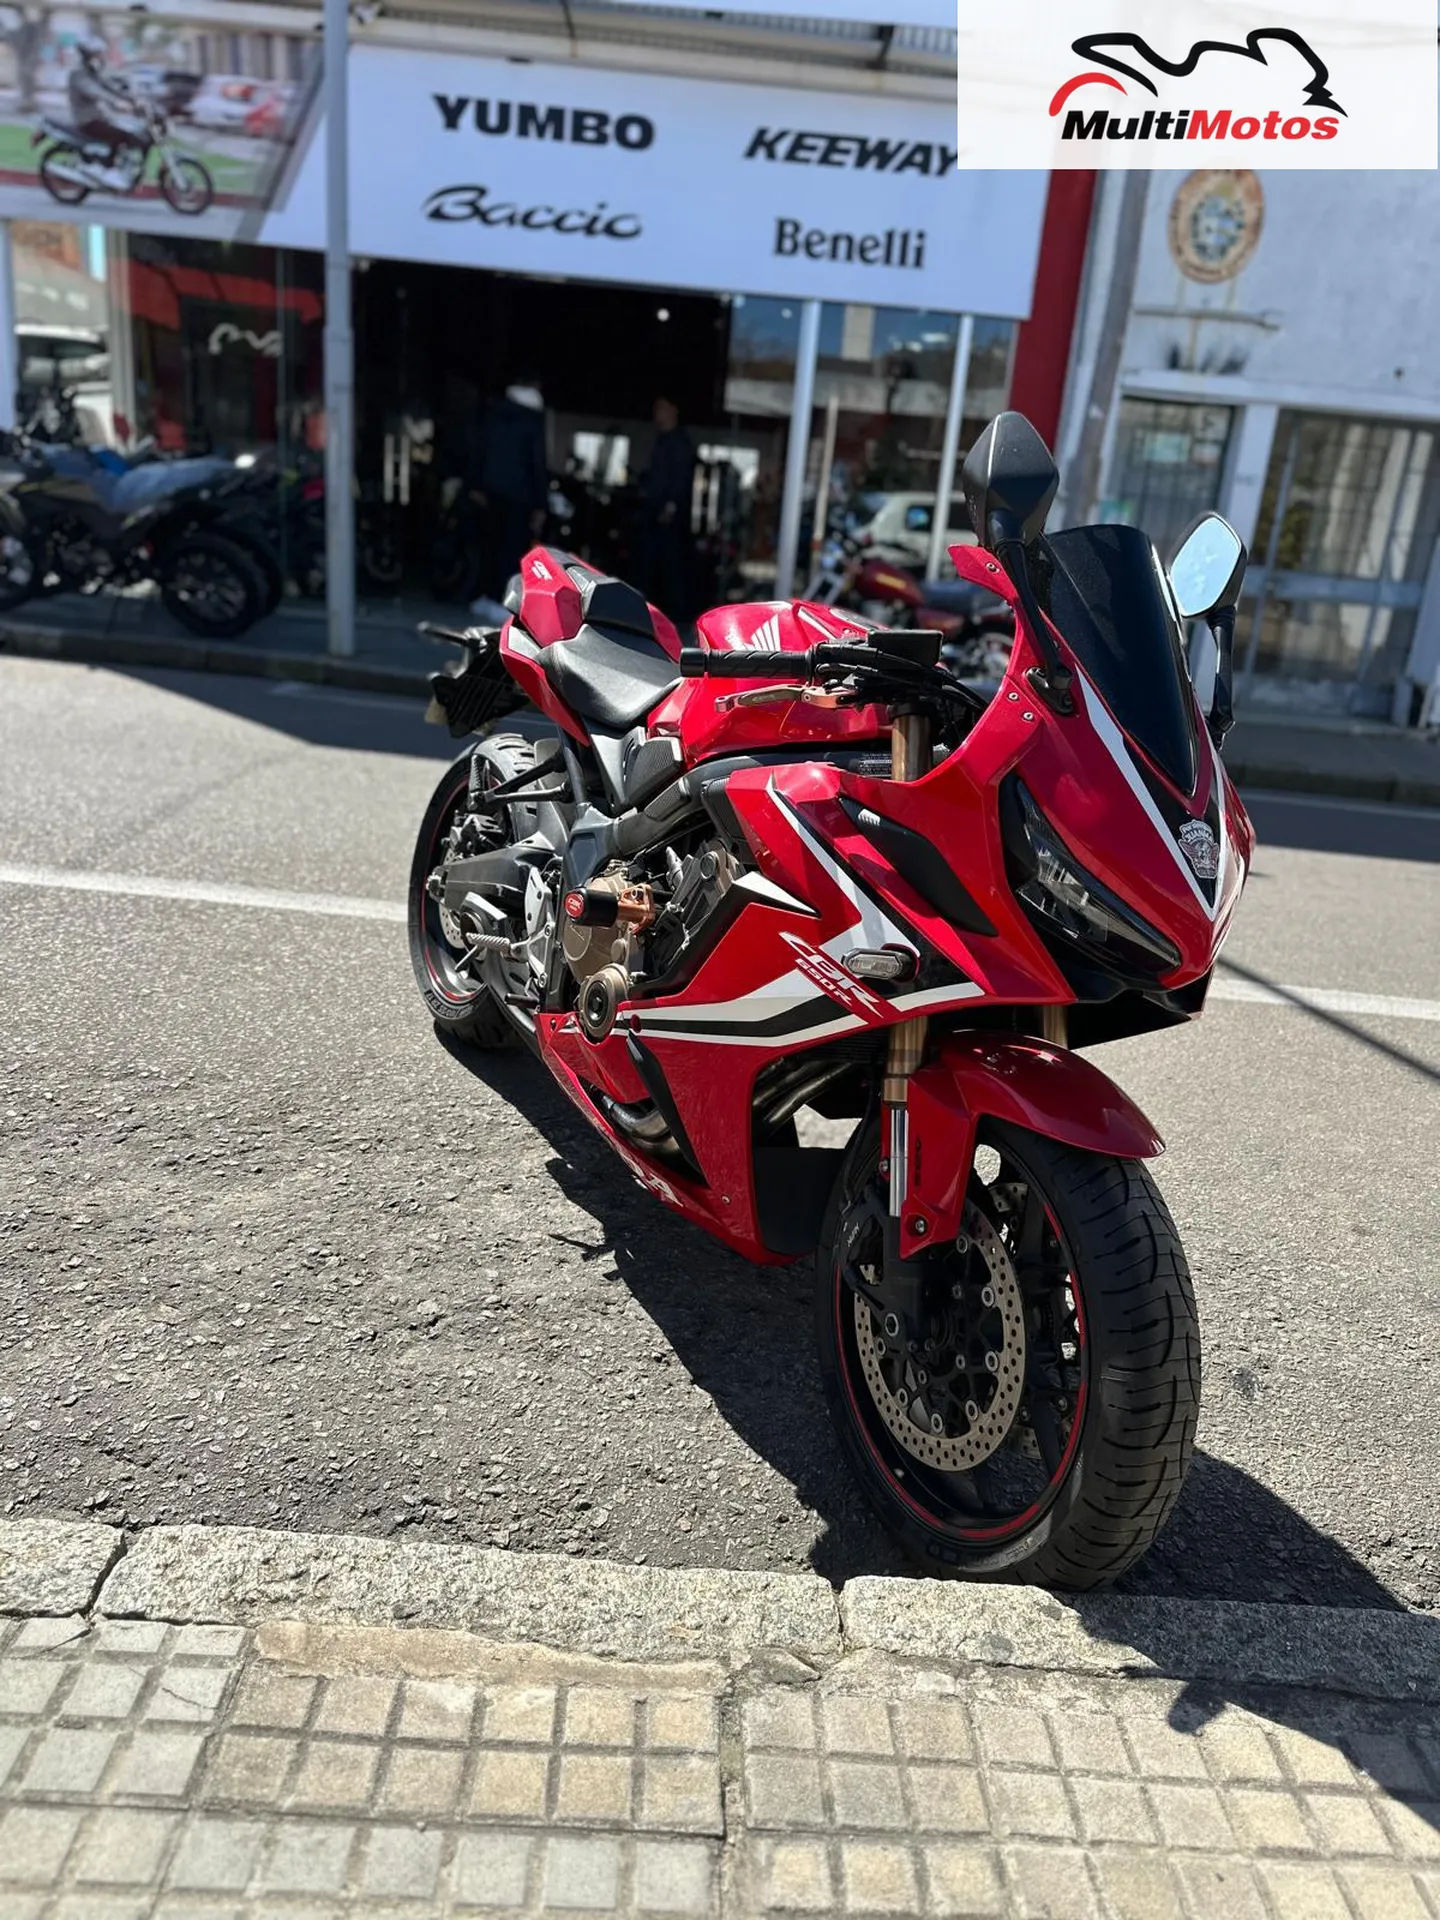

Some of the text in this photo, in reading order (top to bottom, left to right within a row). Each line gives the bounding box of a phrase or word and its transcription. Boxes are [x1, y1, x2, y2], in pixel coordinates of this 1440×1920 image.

[433, 94, 655, 150] YUMBO
[743, 127, 958, 177] KEEWAY
[424, 185, 642, 239] Baccio
[774, 217, 926, 269] Benelli
[778, 930, 885, 1019] CBR
[794, 957, 853, 1007] 650R
